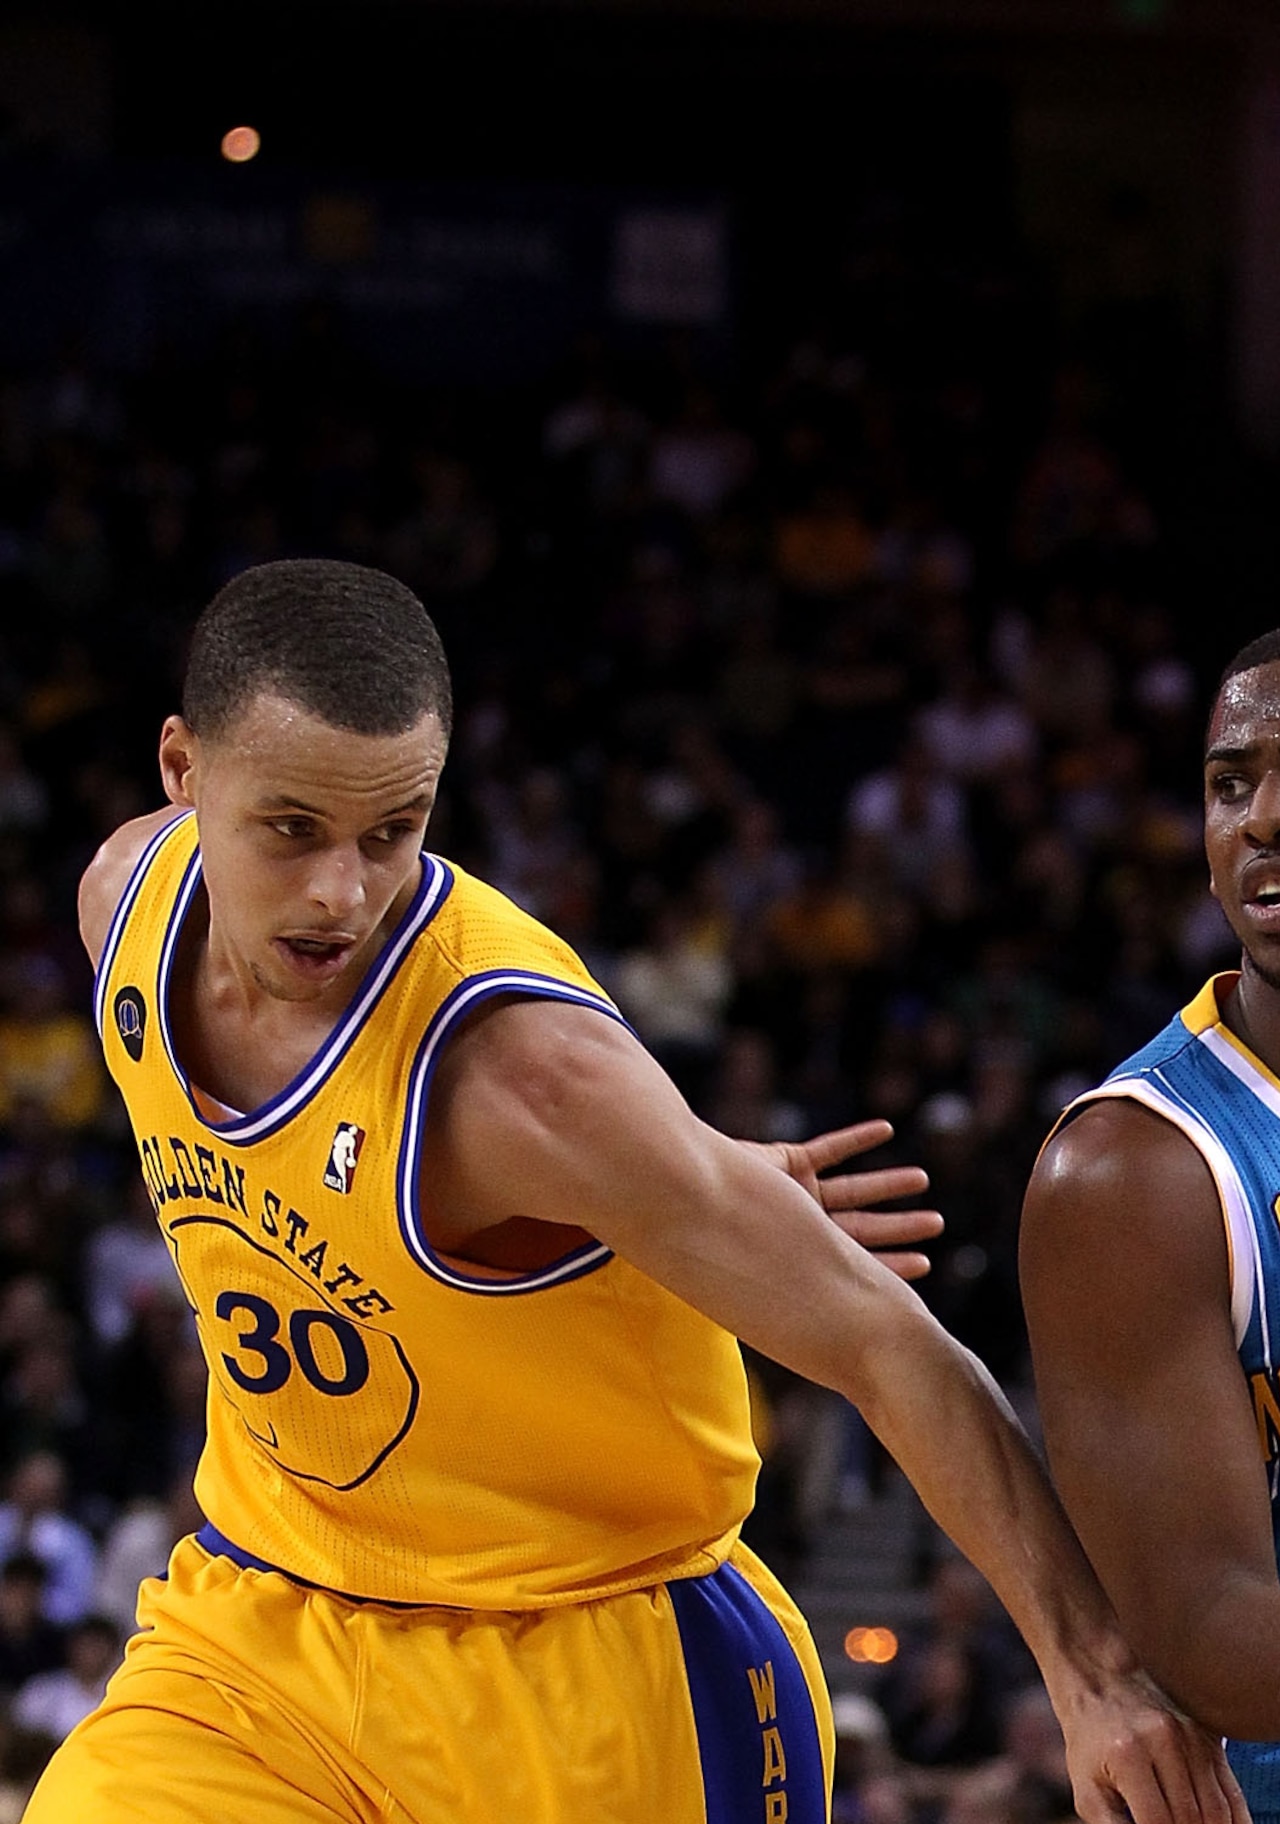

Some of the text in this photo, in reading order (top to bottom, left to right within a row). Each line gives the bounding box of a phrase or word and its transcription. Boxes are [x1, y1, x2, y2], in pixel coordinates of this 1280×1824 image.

[142, 1136, 396, 1320] OLDEN STATE
[214, 1290, 370, 1397] 30
